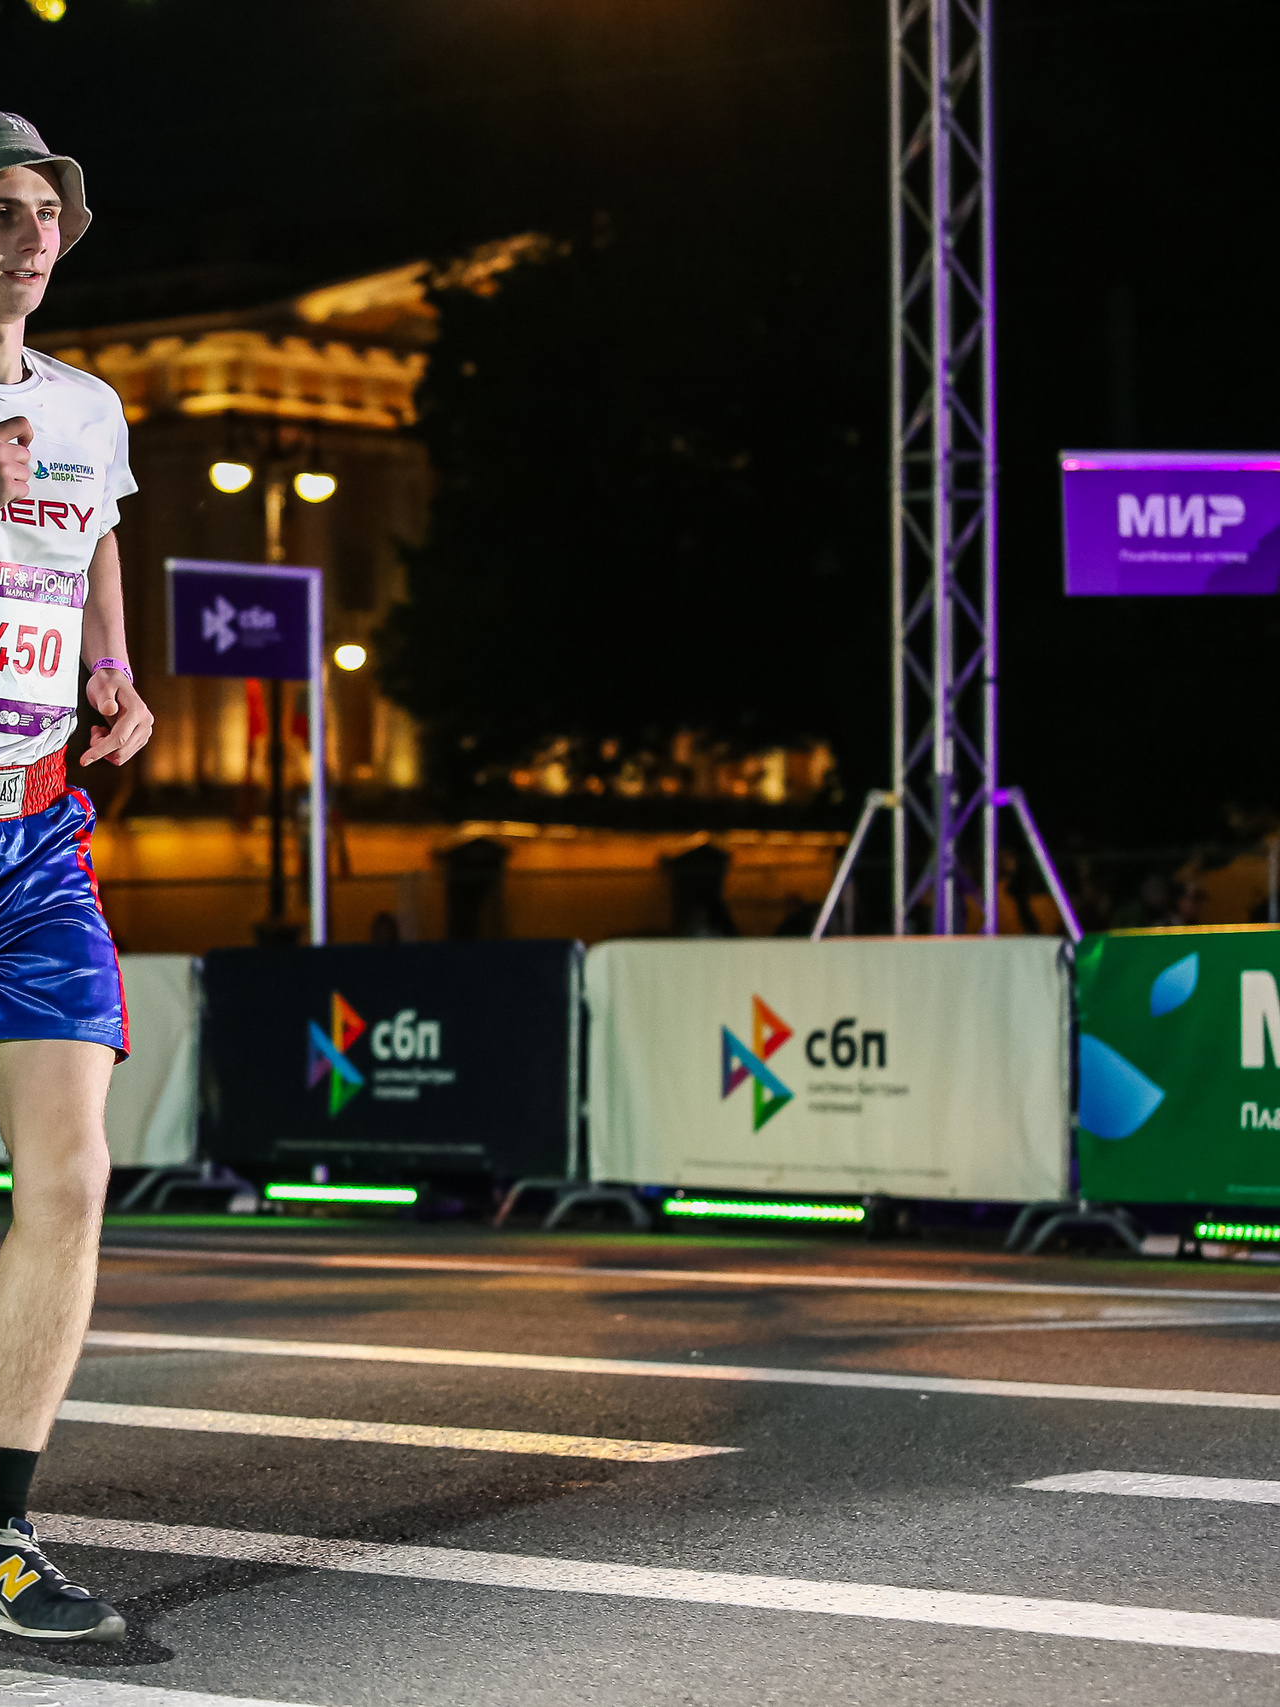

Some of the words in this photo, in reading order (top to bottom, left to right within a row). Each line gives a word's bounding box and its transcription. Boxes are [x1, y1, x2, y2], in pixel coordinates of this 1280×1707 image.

[51, 472, 76, 482] ДОБРА
[0, 499, 95, 533] ERY
[1118, 493, 1247, 538] МИР
[32, 571, 74, 596] НОЧИ
[371, 1009, 441, 1061] сбп
[805, 1017, 887, 1069] сбп
